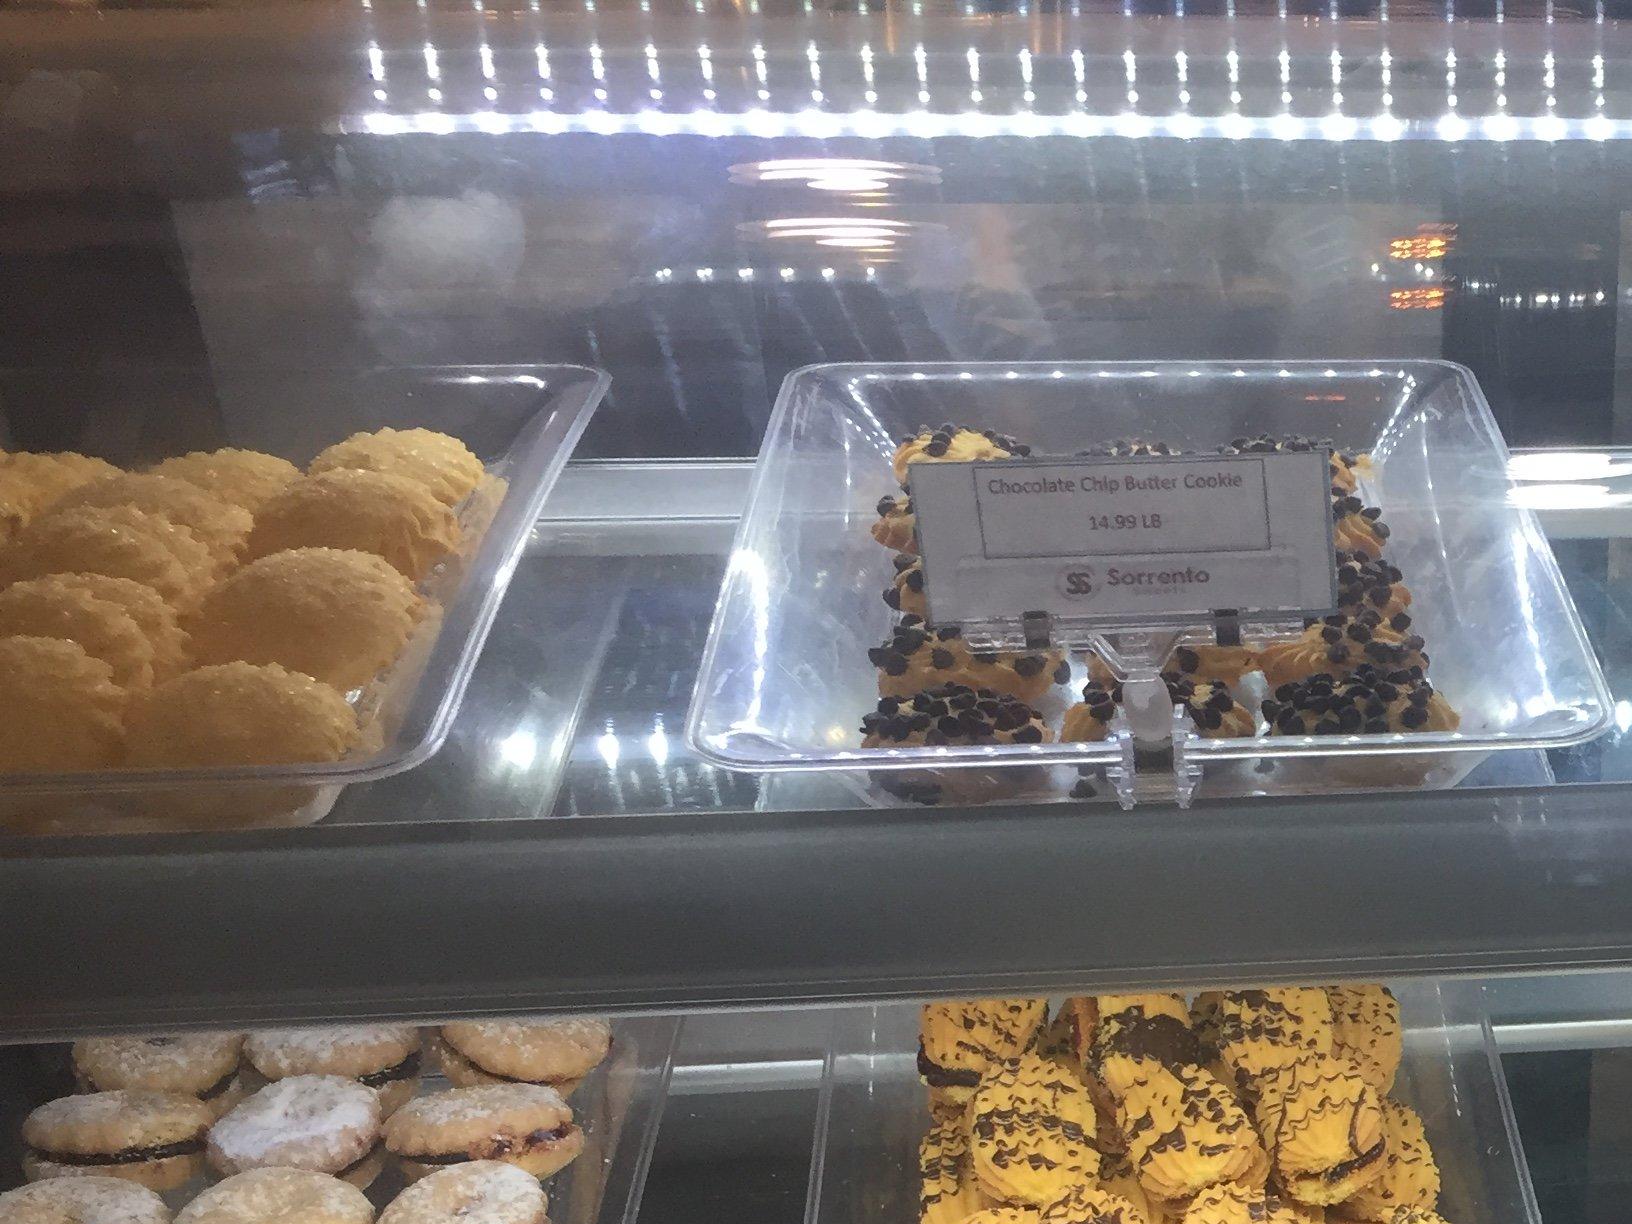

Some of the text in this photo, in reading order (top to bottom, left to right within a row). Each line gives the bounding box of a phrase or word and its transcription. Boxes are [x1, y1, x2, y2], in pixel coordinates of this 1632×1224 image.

[987, 472, 1243, 495] Chocolate Chip Butter Cookie
[1089, 513, 1162, 531] 14.99 LB
[1107, 566, 1211, 587] Sorrento
